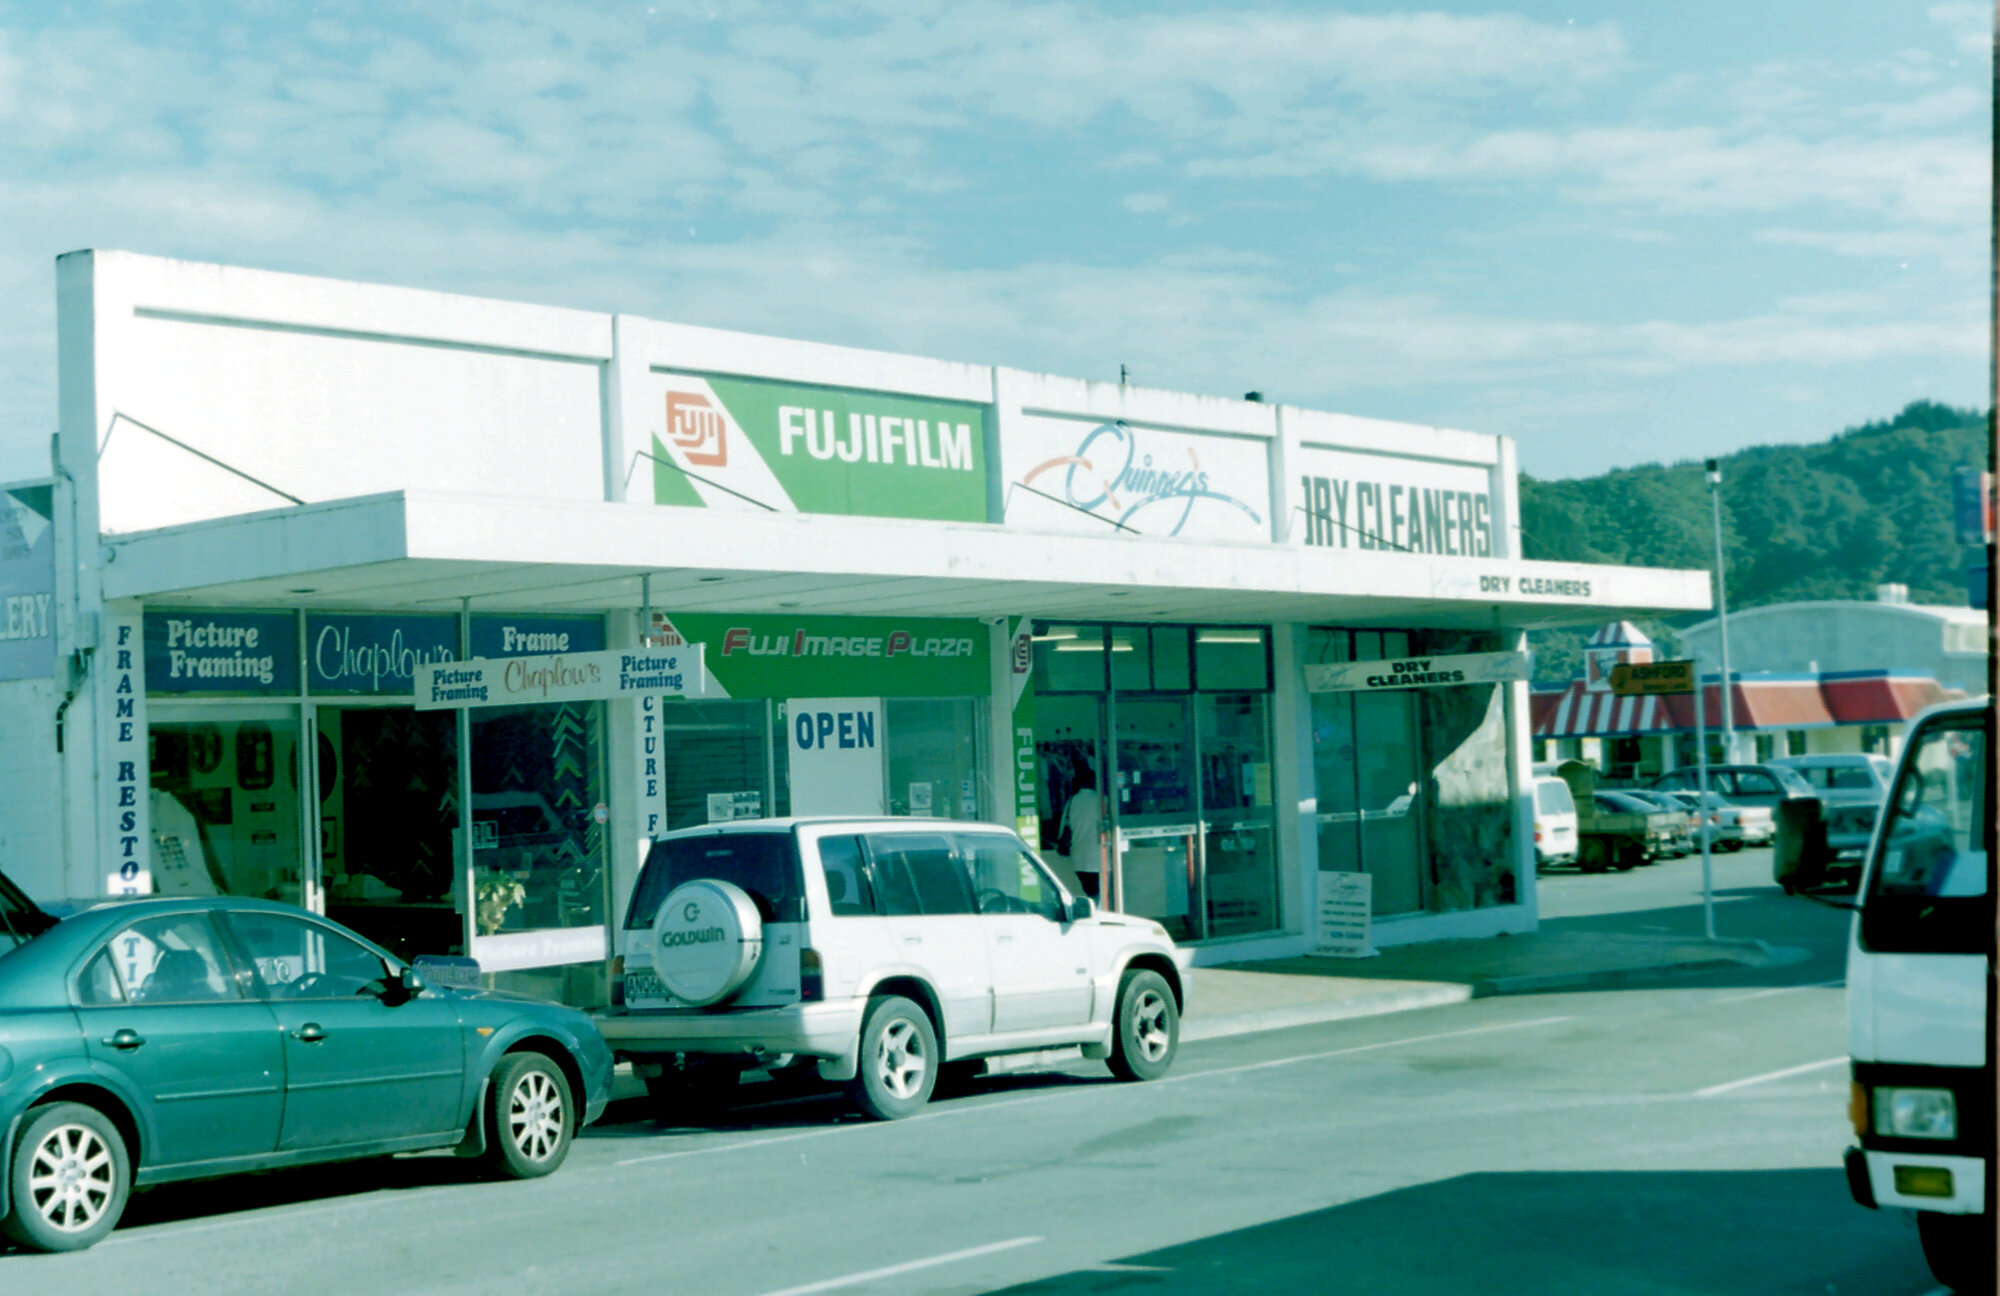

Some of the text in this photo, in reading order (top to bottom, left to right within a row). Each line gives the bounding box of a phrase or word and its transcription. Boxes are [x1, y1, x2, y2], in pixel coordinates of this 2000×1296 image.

[778, 405, 974, 471] FUJIFILM
[1356, 481, 1491, 558] CLEANERS
[1480, 575, 1510, 593] DRY
[1518, 577, 1591, 597] CLEANERS
[0, 593, 50, 639] ERY
[167, 620, 259, 648] Picture
[502, 626, 569, 652] Frame
[792, 628, 882, 657] IMAGE
[886, 630, 973, 658] PLAZA
[169, 650, 274, 684] Framing
[433, 669, 483, 686] Picture
[504, 656, 601, 697] Chaplow's
[620, 655, 677, 673] Picture
[1366, 669, 1465, 687] CLEANERS
[1391, 660, 1431, 673] DRY
[116, 626, 134, 742] FRAME
[431, 684, 488, 702] Framing
[619, 672, 683, 690] Framing
[795, 711, 875, 750] OPEN
